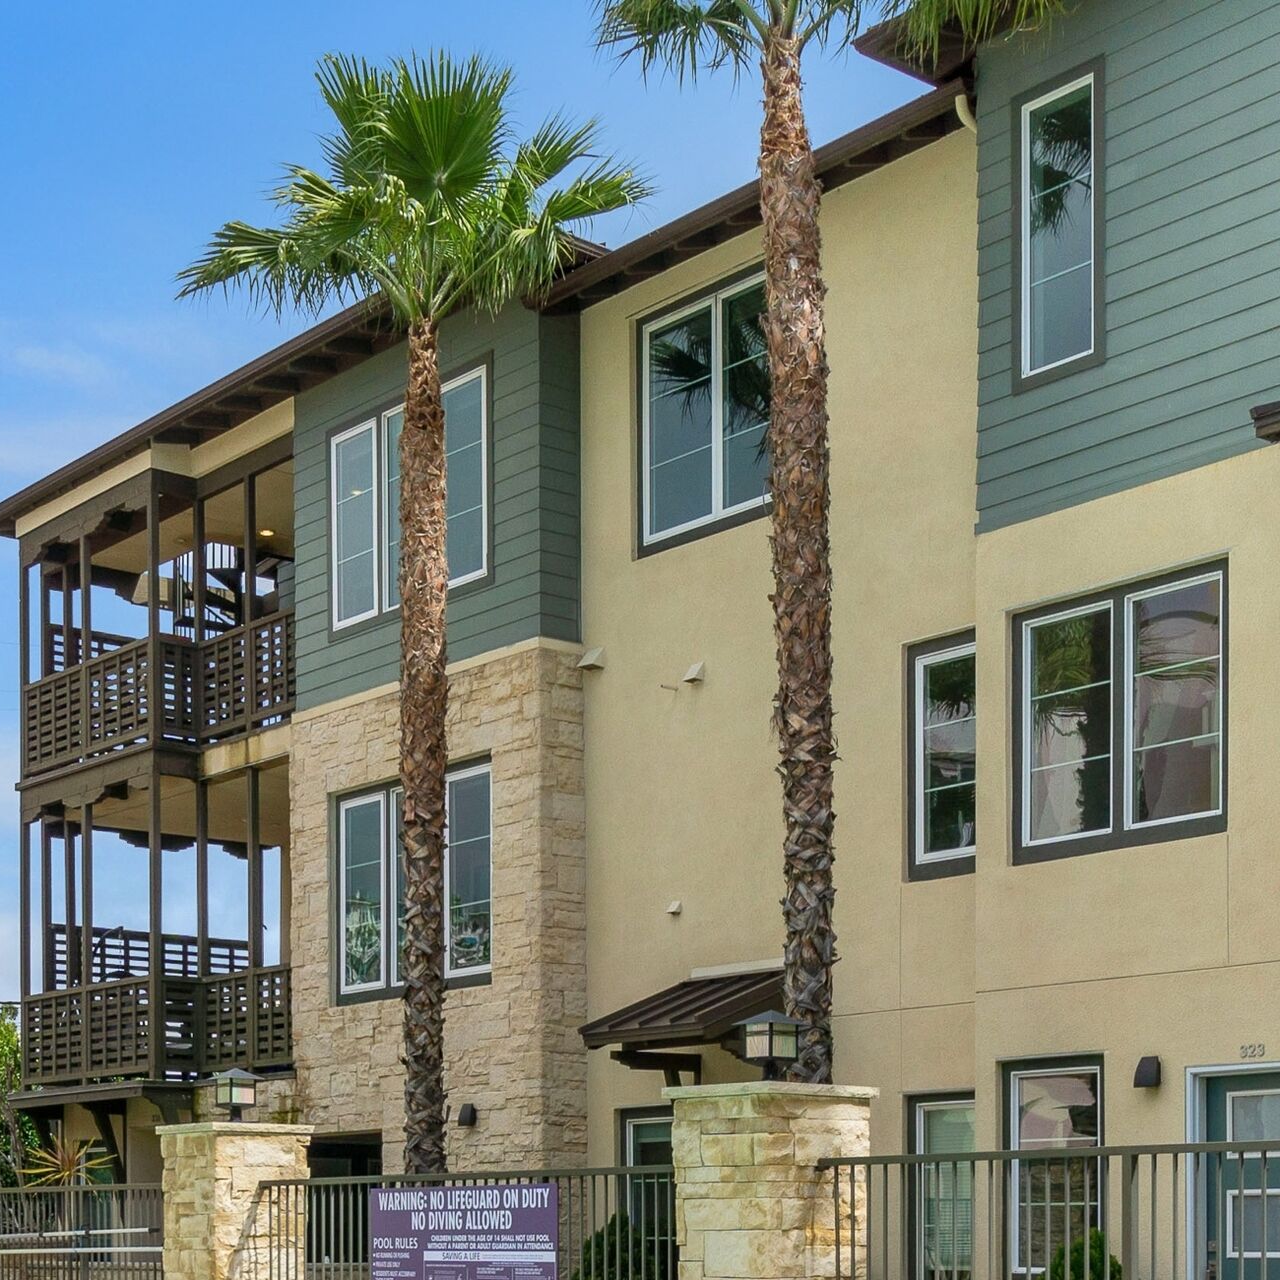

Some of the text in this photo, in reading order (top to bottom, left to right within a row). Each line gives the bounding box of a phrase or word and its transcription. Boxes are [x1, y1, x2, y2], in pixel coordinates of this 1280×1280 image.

[1240, 1043, 1265, 1059] 323
[378, 1187, 550, 1211] WARNING: NO LIFEGUARD ON DUTY
[411, 1210, 513, 1230] NO DIVING ALLOWED
[373, 1237, 418, 1249] POOL RULES
[442, 1252, 462, 1260] SAVING
[470, 1252, 480, 1260] LIFE
